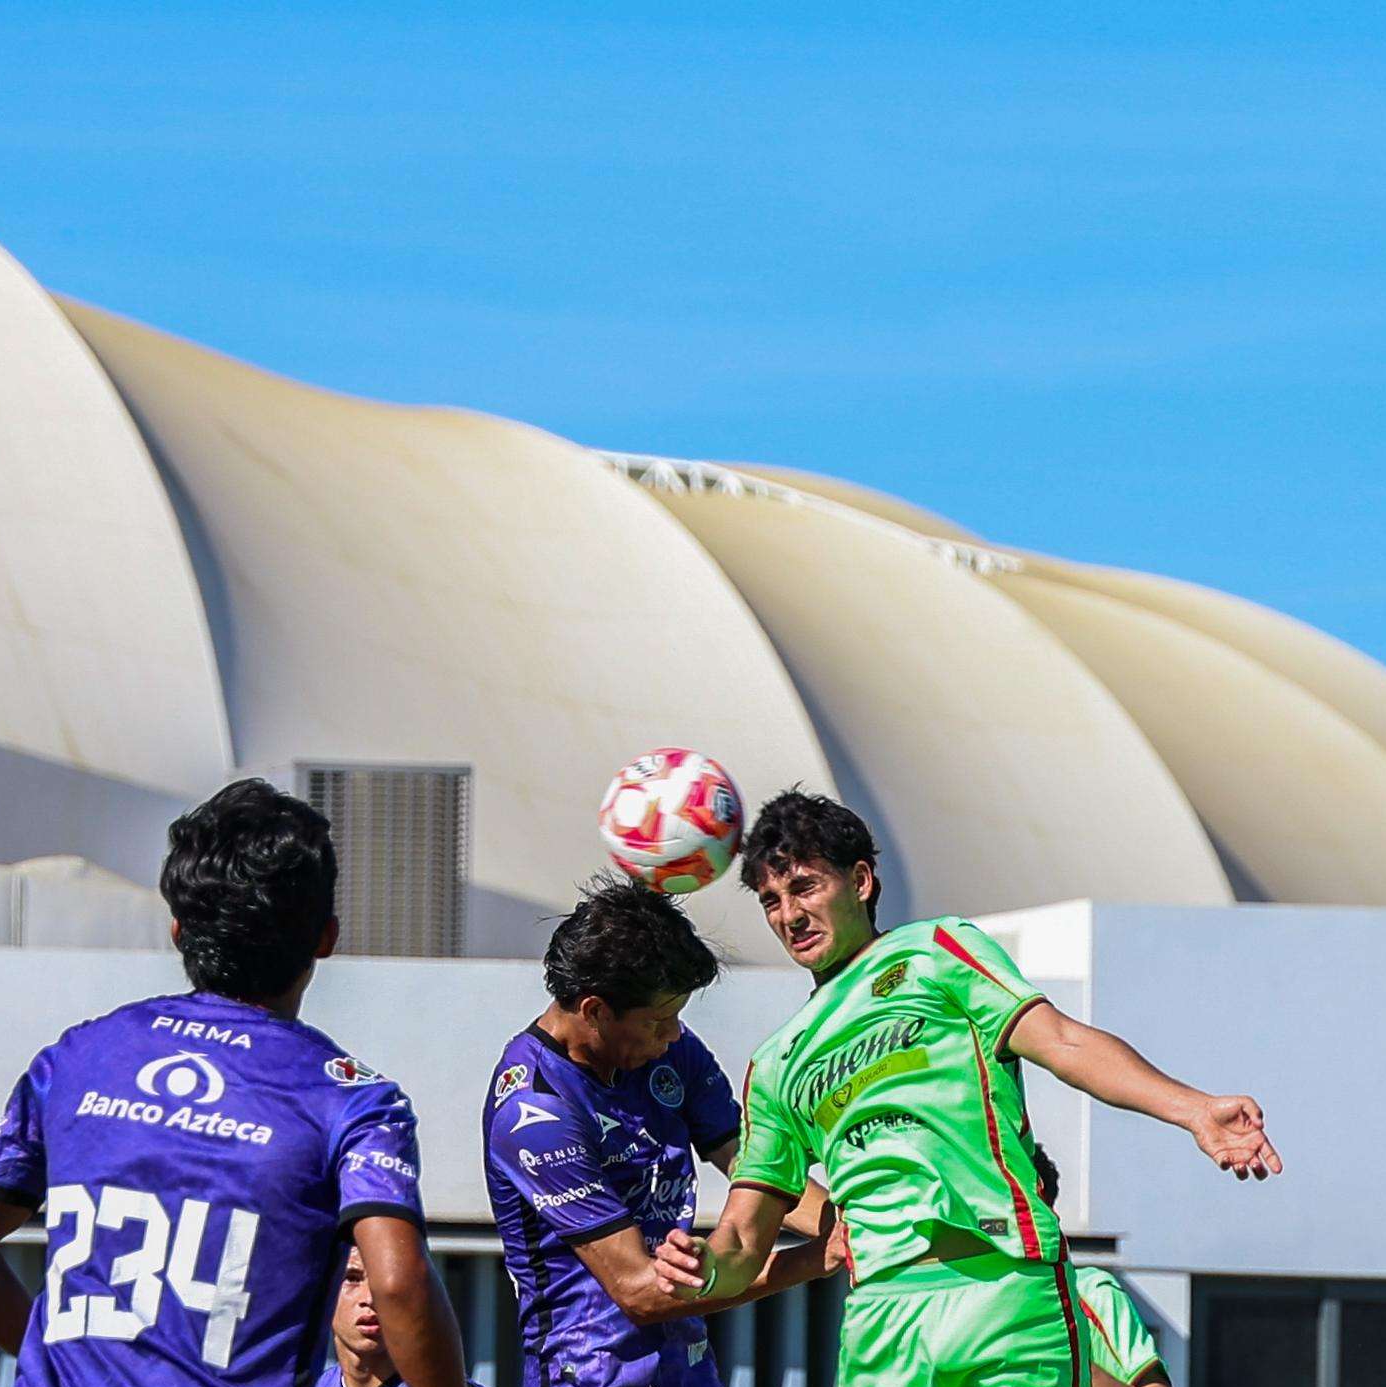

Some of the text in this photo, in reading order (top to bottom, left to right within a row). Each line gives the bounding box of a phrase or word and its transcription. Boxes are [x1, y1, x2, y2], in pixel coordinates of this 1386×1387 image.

[152, 1016, 252, 1050] PIRMA
[77, 1091, 273, 1145] Banco Azteca
[43, 1184, 260, 1369] 234
